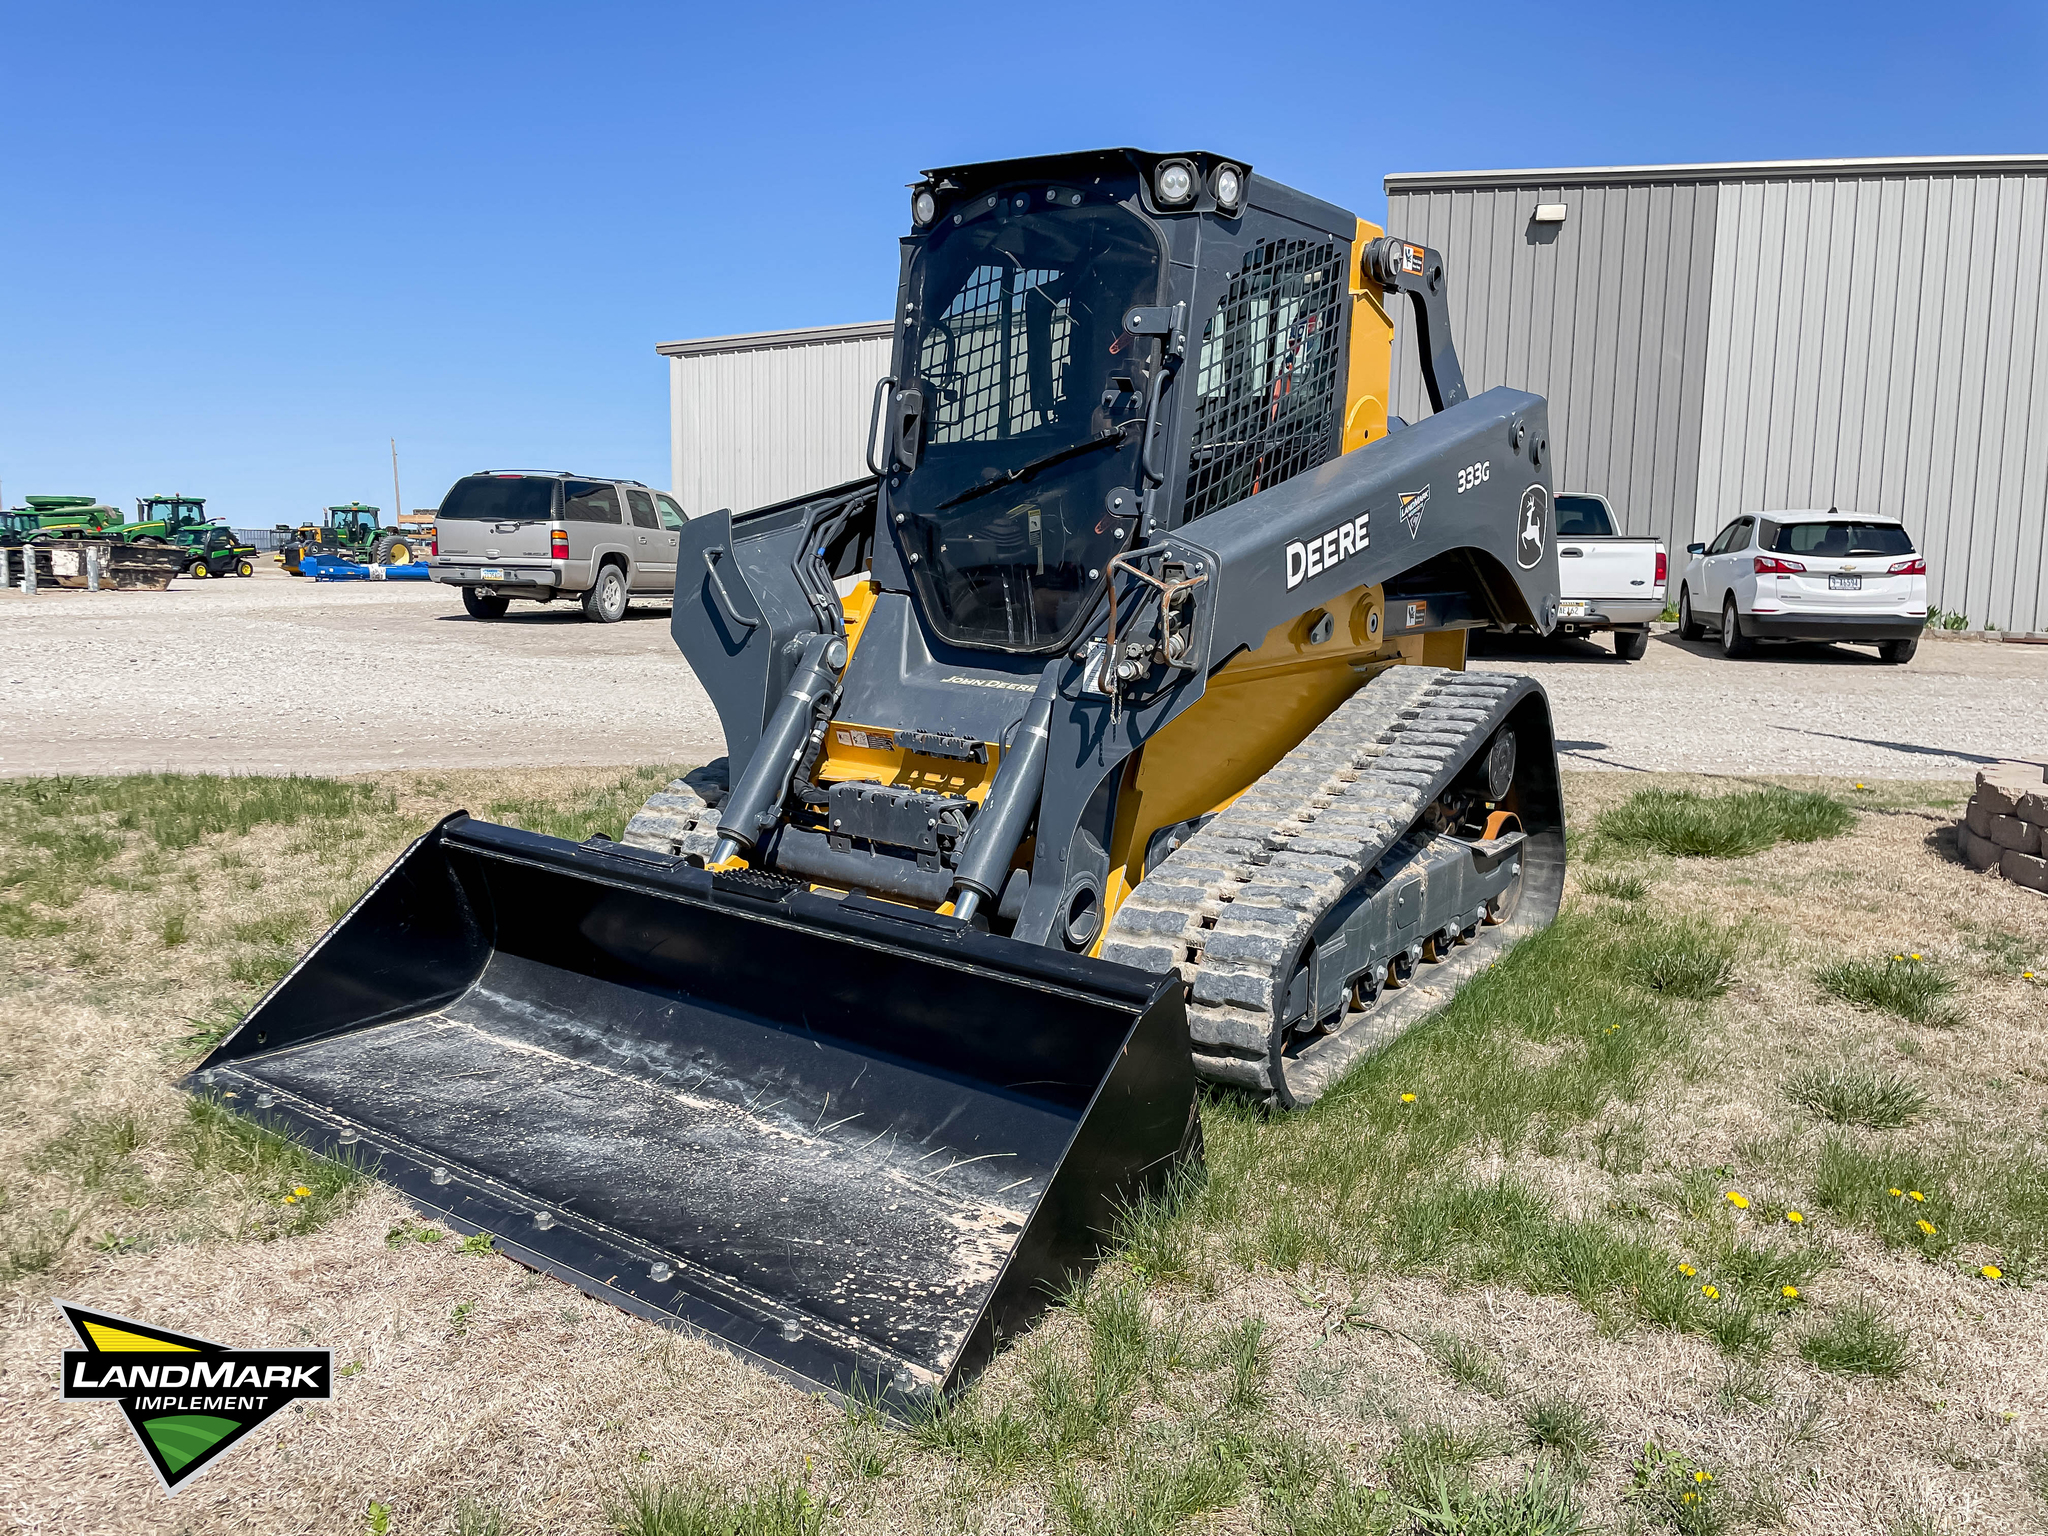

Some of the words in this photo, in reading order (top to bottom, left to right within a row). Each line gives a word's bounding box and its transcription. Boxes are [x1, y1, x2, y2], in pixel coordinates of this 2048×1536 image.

[1457, 461, 1490, 494] 333G
[1286, 513, 1370, 590] DEERE
[940, 676, 985, 687] JOHN
[985, 680, 1038, 693] DEERE
